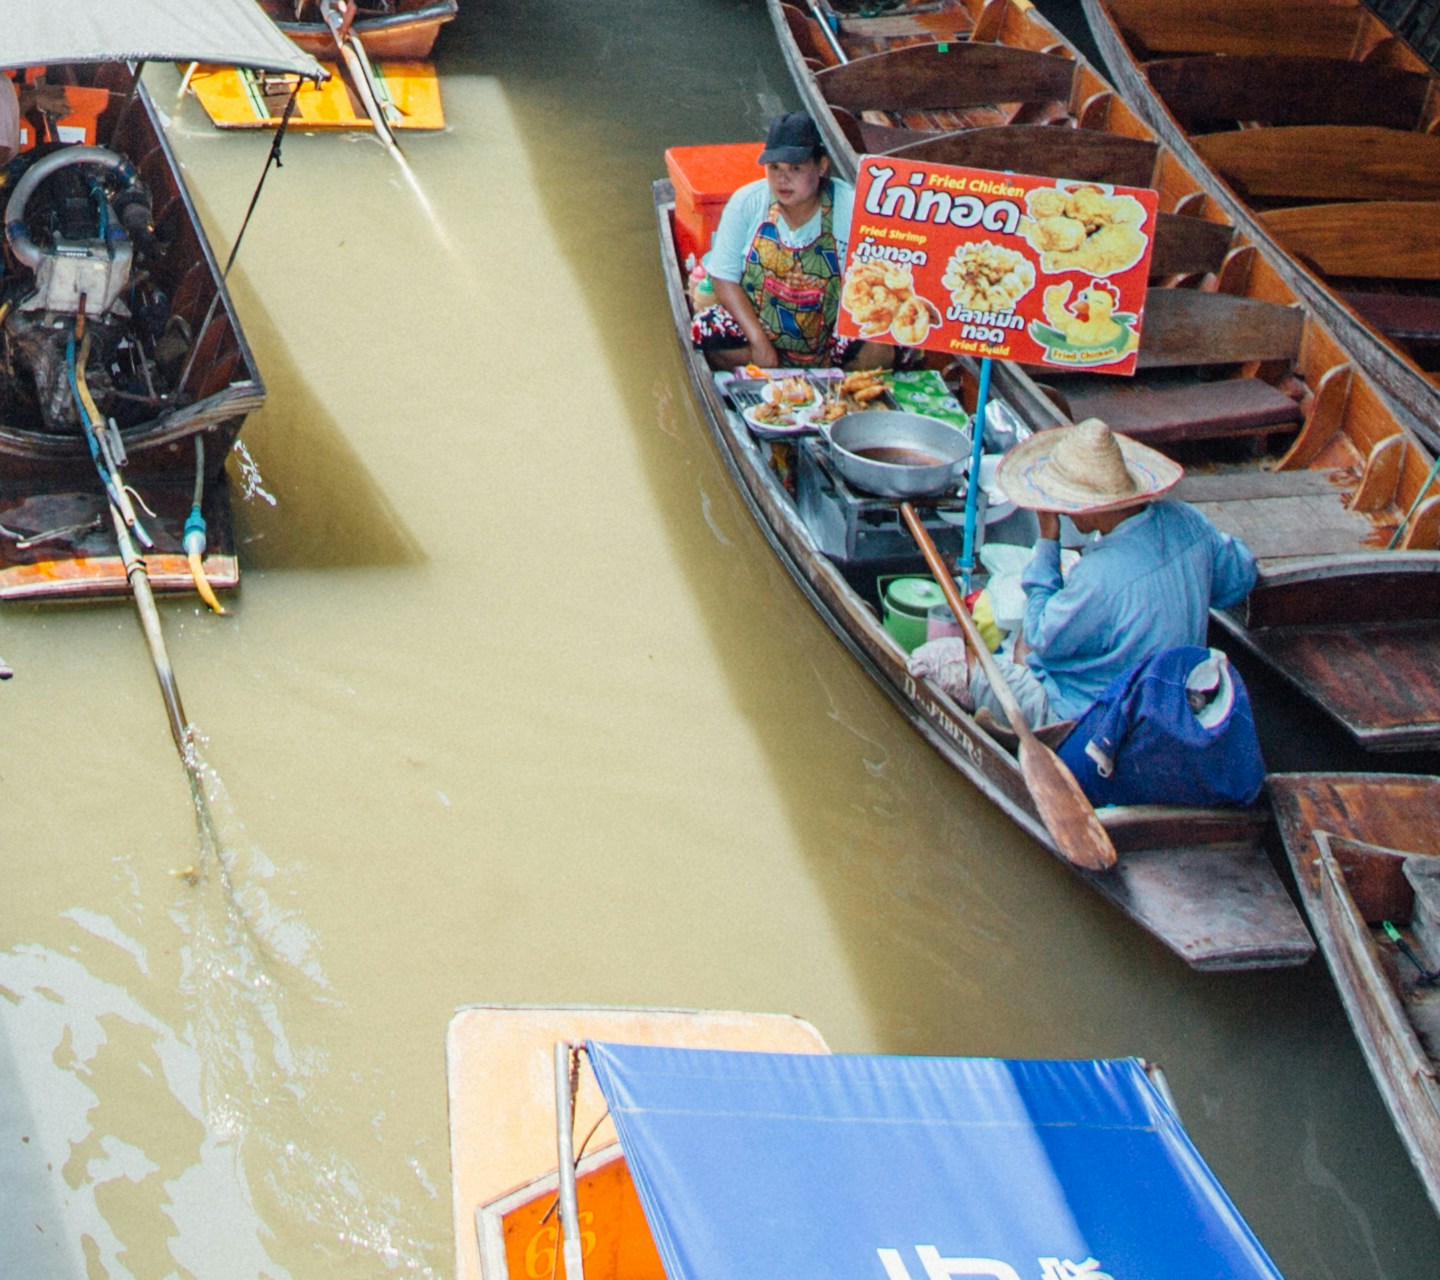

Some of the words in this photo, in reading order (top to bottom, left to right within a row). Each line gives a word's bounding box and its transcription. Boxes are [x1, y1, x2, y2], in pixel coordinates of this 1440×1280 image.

[928, 173, 967, 191] Fried
[969, 179, 1025, 198] Chicken
[865, 165, 1022, 236] ไก่ทอด
[859, 224, 887, 239] Fried
[888, 228, 928, 245] Shrimp
[856, 235, 929, 267] กุ้งทอด
[945, 304, 1026, 332] ปลาหมึก
[960, 323, 1006, 345] ทอด
[949, 338, 977, 353] Fried
[978, 342, 1011, 358] Squid
[1052, 349, 1077, 361] Fried
[1080, 347, 1116, 361] Chicken
